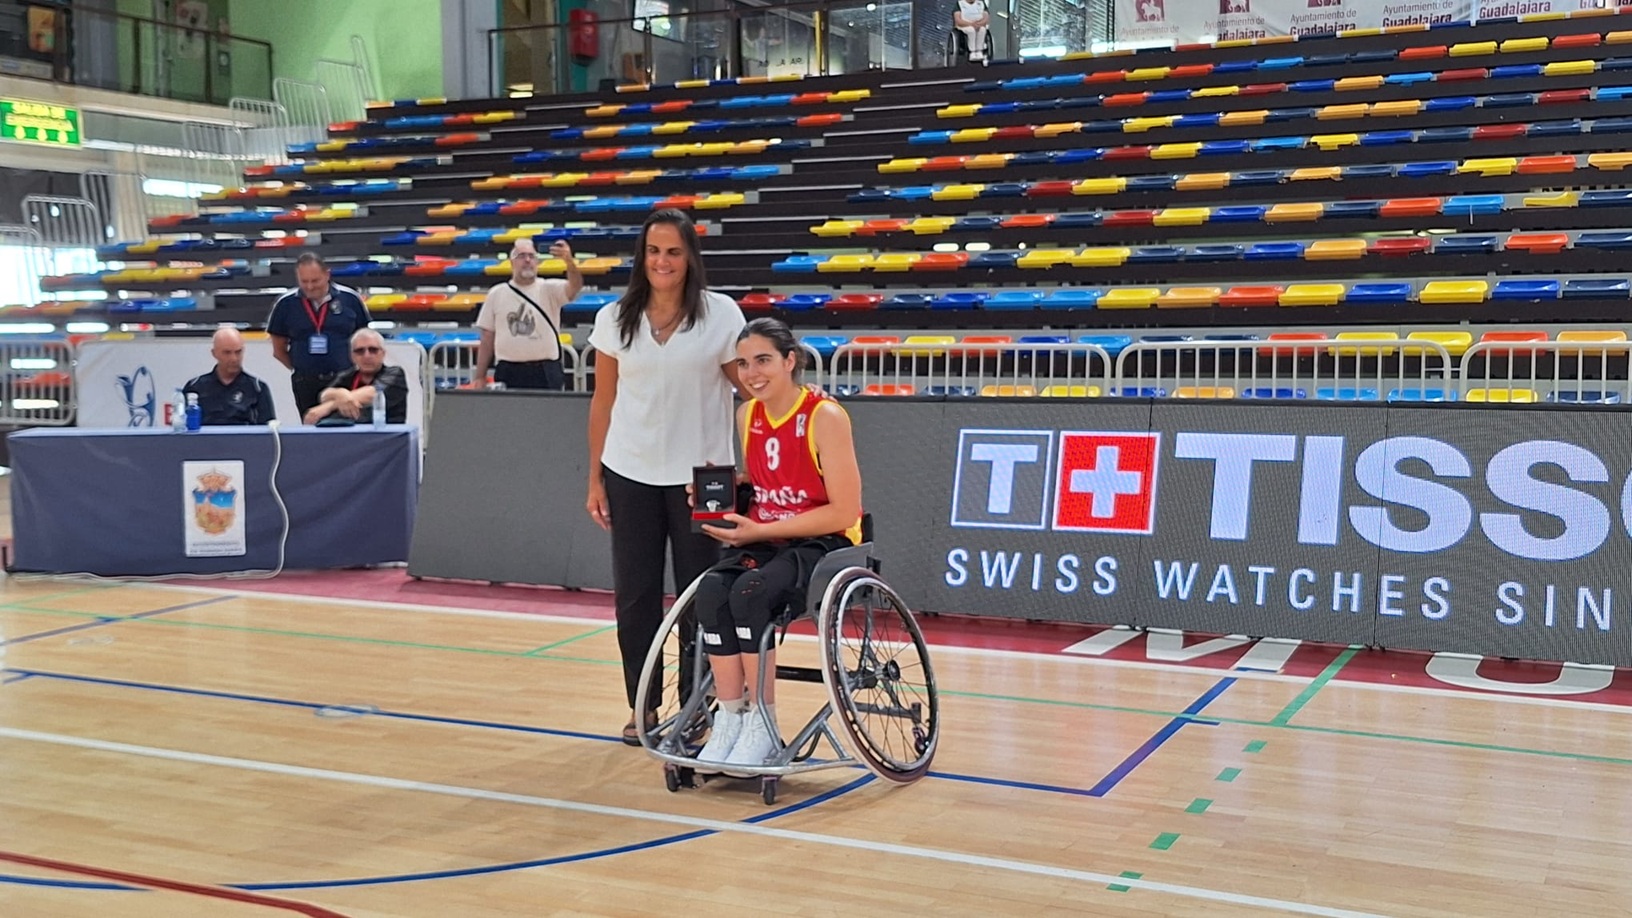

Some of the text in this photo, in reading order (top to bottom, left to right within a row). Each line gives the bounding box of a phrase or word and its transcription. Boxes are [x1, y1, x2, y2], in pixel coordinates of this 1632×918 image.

[1290, 8, 1357, 25] Ayuntamiento de
[1383, 3, 1441, 17] Ayuntamiento
[1479, 0, 1551, 18] Guadalajara
[753, 485, 808, 506] SPAÑA
[1175, 433, 1632, 560] TISS
[945, 548, 1611, 630] SWISS WATCHES SIN
